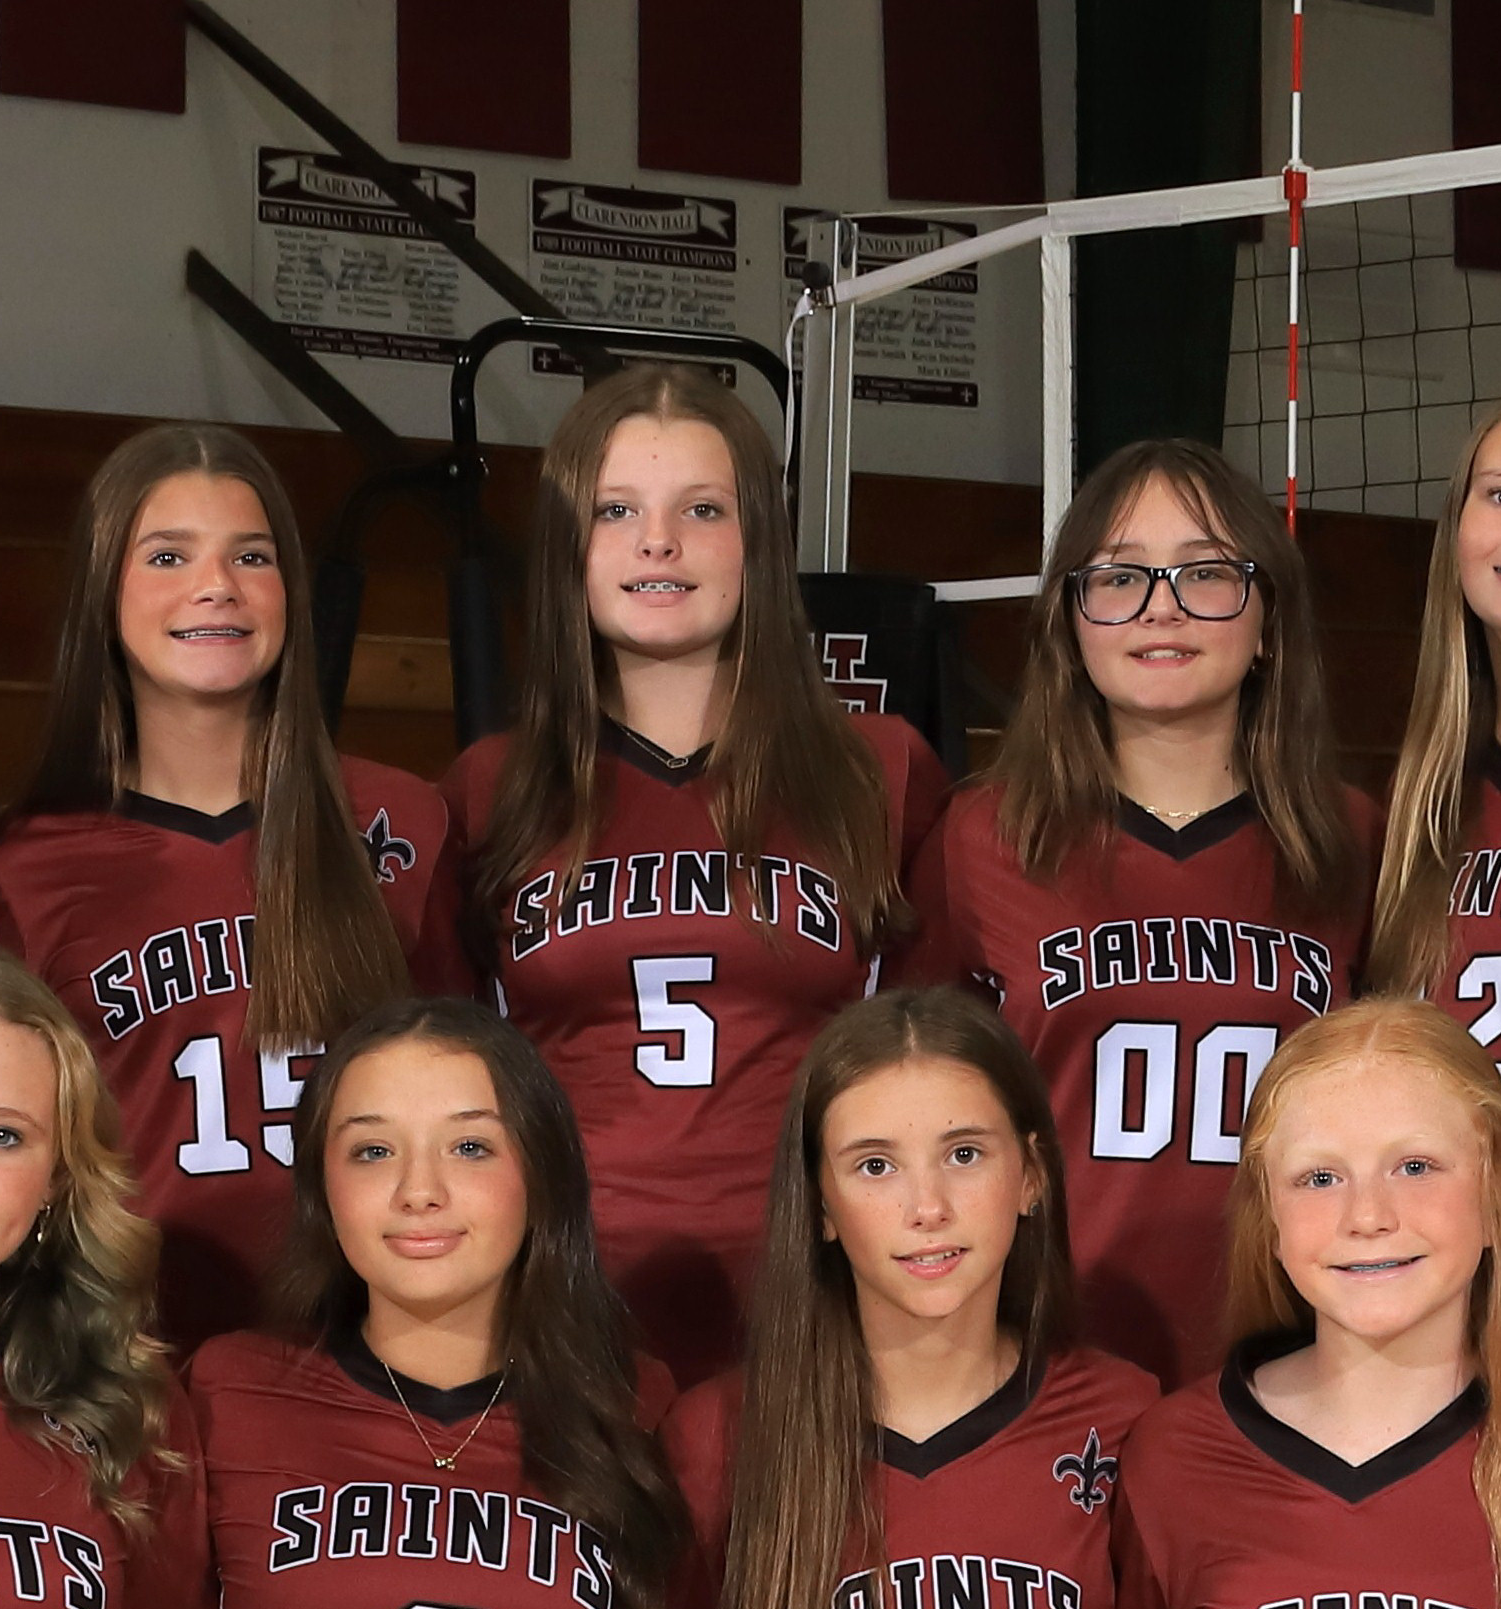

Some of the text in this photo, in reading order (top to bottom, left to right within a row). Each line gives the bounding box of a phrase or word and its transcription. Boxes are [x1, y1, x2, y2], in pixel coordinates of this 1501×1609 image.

[288, 207, 355, 229] FOOTBALL
[357, 216, 395, 234] STATE
[305, 171, 385, 199] CLARENDO
[575, 202, 693, 231] CLARENDON HALL
[561, 237, 622, 258] FOOTBALL
[626, 244, 661, 261] STATE
[663, 248, 735, 267] CHAMPIONS
[511, 850, 840, 962] SAINTS
[89, 914, 256, 1041] SAI
[629, 953, 718, 1088] 5
[1039, 917, 1332, 1018] SAINTS
[172, 1033, 328, 1176] 15
[1091, 1020, 1279, 1165] 00
